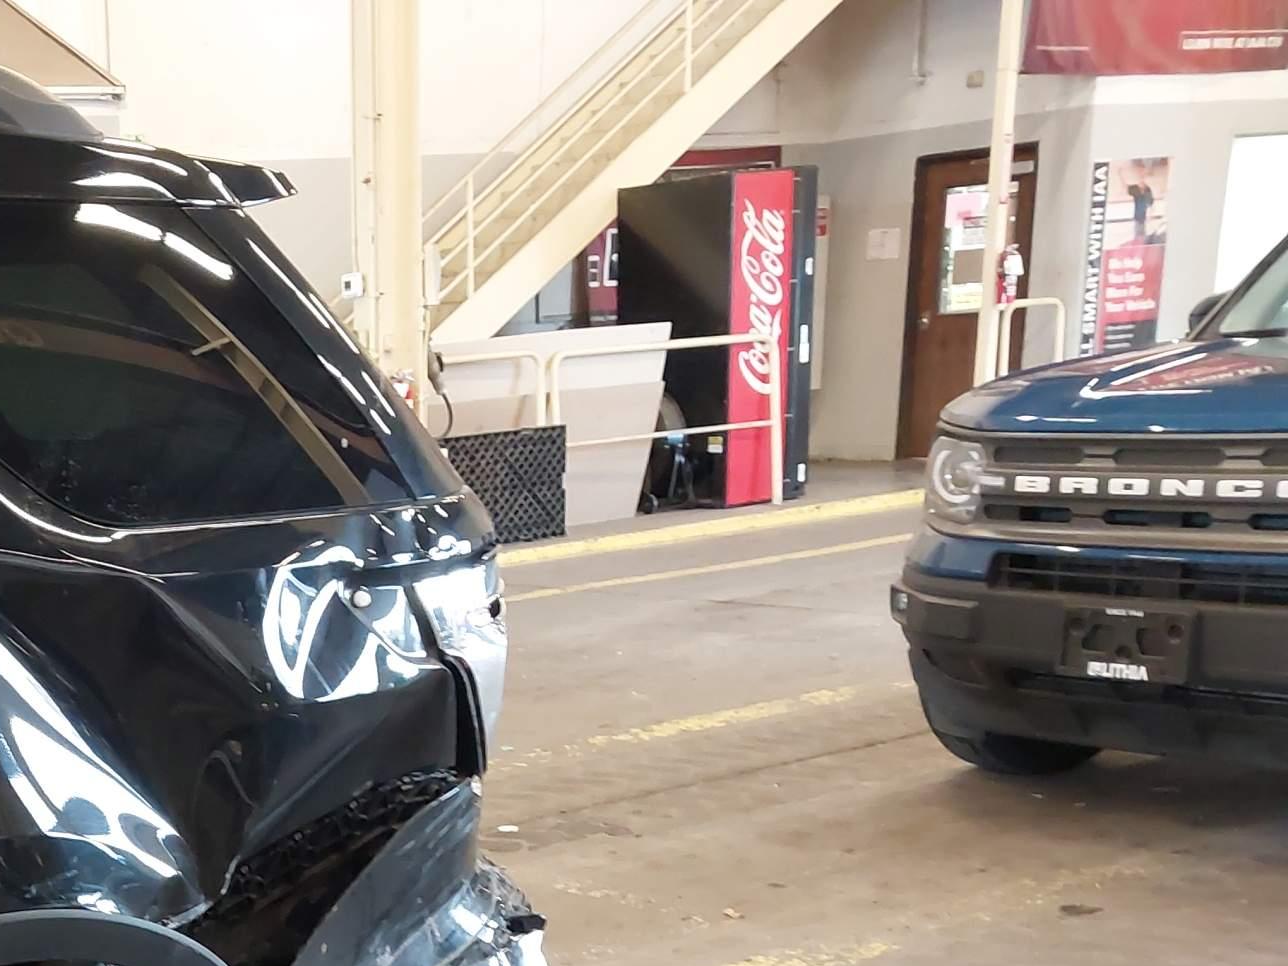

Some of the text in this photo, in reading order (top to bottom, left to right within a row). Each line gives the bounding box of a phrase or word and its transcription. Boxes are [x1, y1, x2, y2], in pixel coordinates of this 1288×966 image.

[1091, 166, 1107, 201] IAA
[1087, 207, 1104, 261] WITH
[1082, 266, 1099, 334] SMART
[1014, 475, 1288, 498] BRONC
